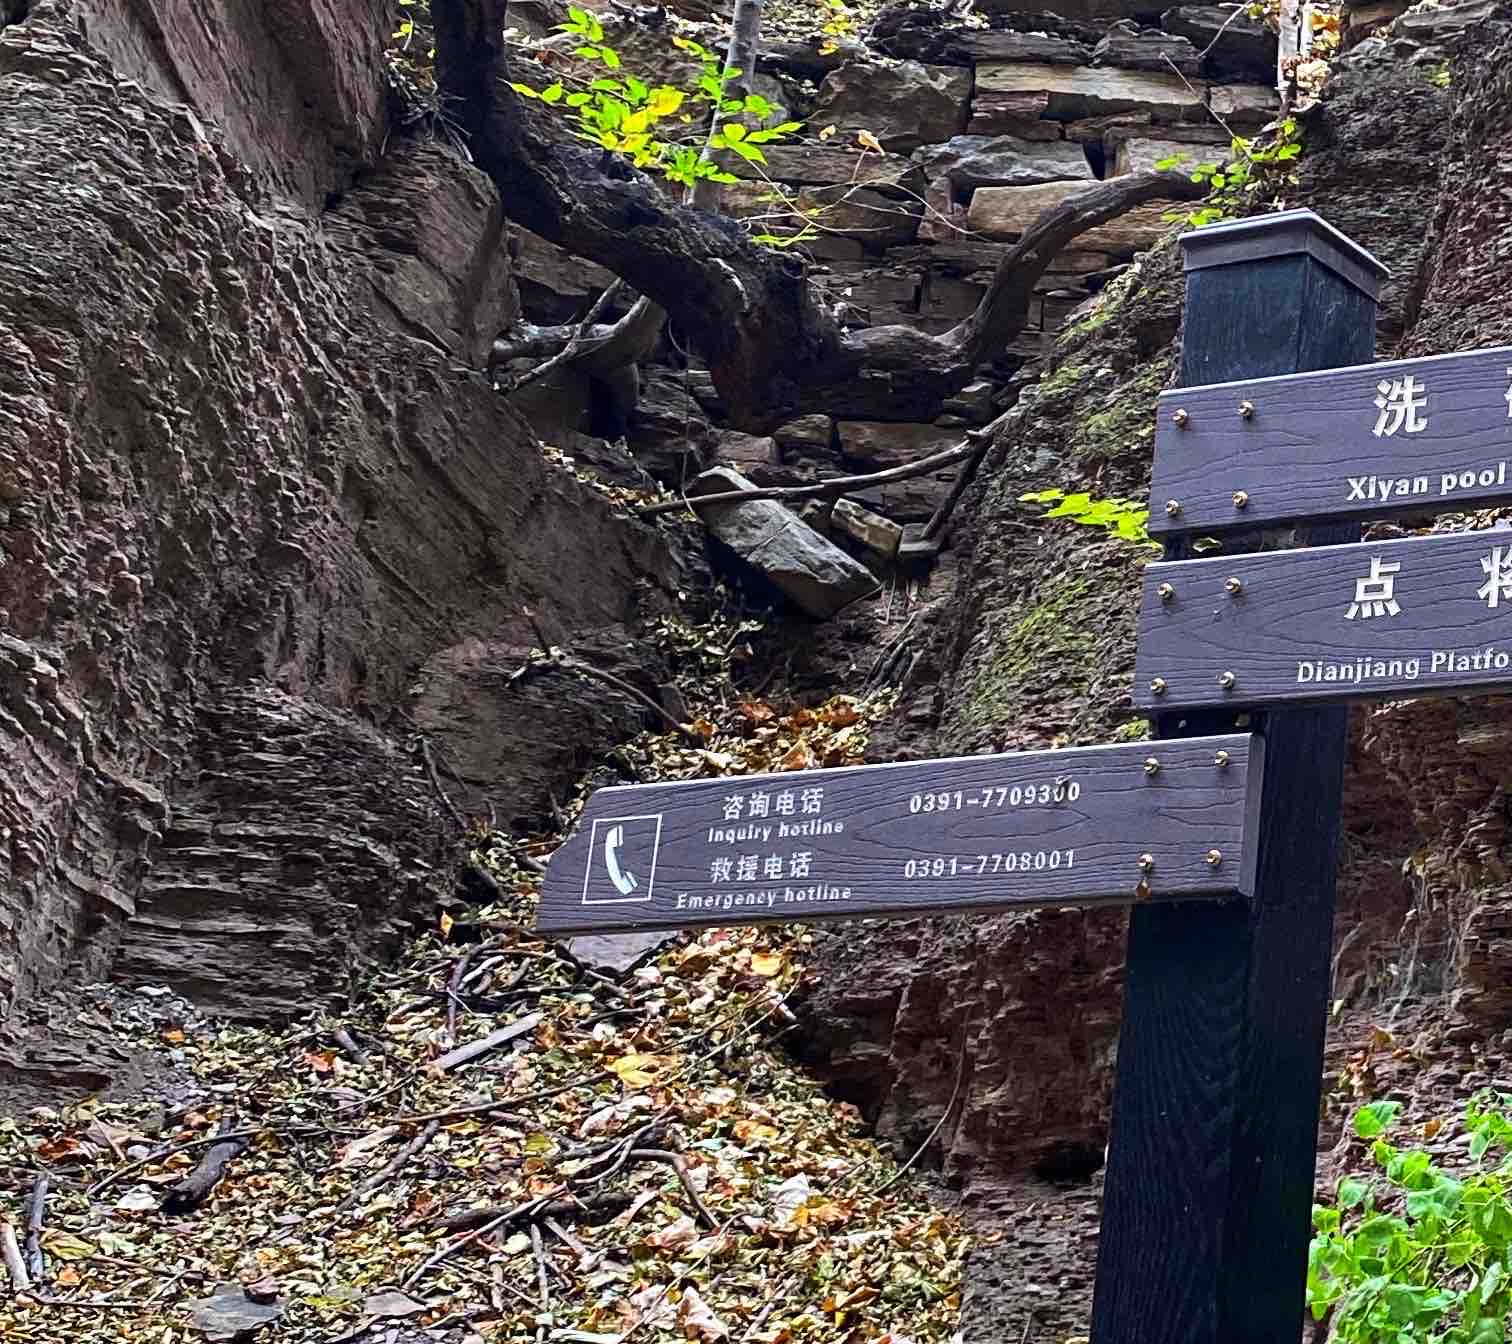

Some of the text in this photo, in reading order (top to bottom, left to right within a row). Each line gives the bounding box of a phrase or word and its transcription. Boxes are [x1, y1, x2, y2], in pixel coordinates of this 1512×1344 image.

[1345, 462, 1506, 503] Xiyan pool
[1296, 657, 1421, 685] Dianjiang
[722, 787, 824, 820] 咨询电话
[707, 819, 845, 844] Inquiry hotline
[710, 851, 814, 883] 救援电话
[904, 849, 1075, 879] 0391-7708001
[675, 883, 853, 910] Emergency hotline
